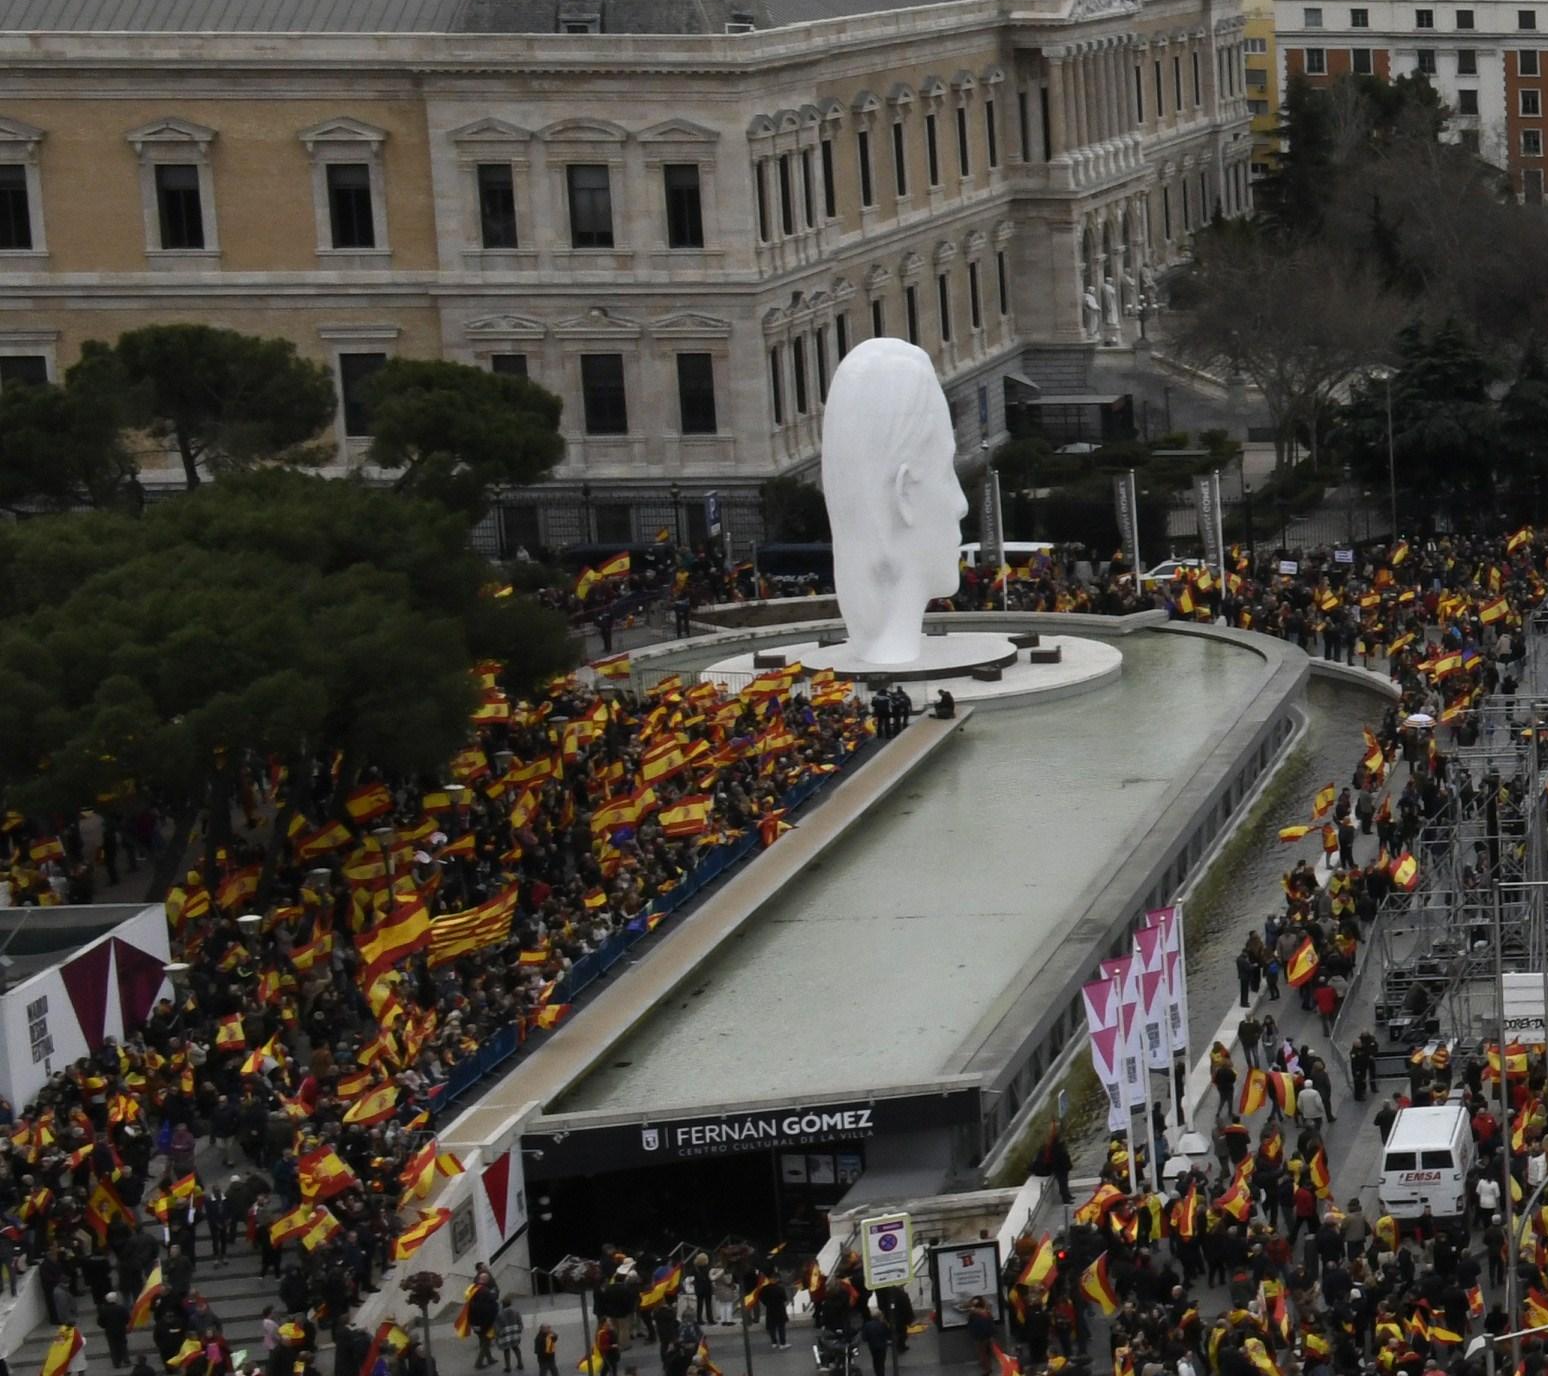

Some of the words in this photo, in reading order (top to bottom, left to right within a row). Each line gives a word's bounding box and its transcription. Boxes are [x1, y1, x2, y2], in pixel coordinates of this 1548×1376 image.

[676, 1117, 777, 1146] FERNÁN
[782, 1110, 873, 1135] GÓMEZ
[679, 1143, 727, 1157] CENTRO
[733, 1136, 795, 1152] CULTURAL
[800, 1135, 816, 1144] DE
[820, 1133, 834, 1142] LA
[840, 1129, 874, 1139] VILLA
